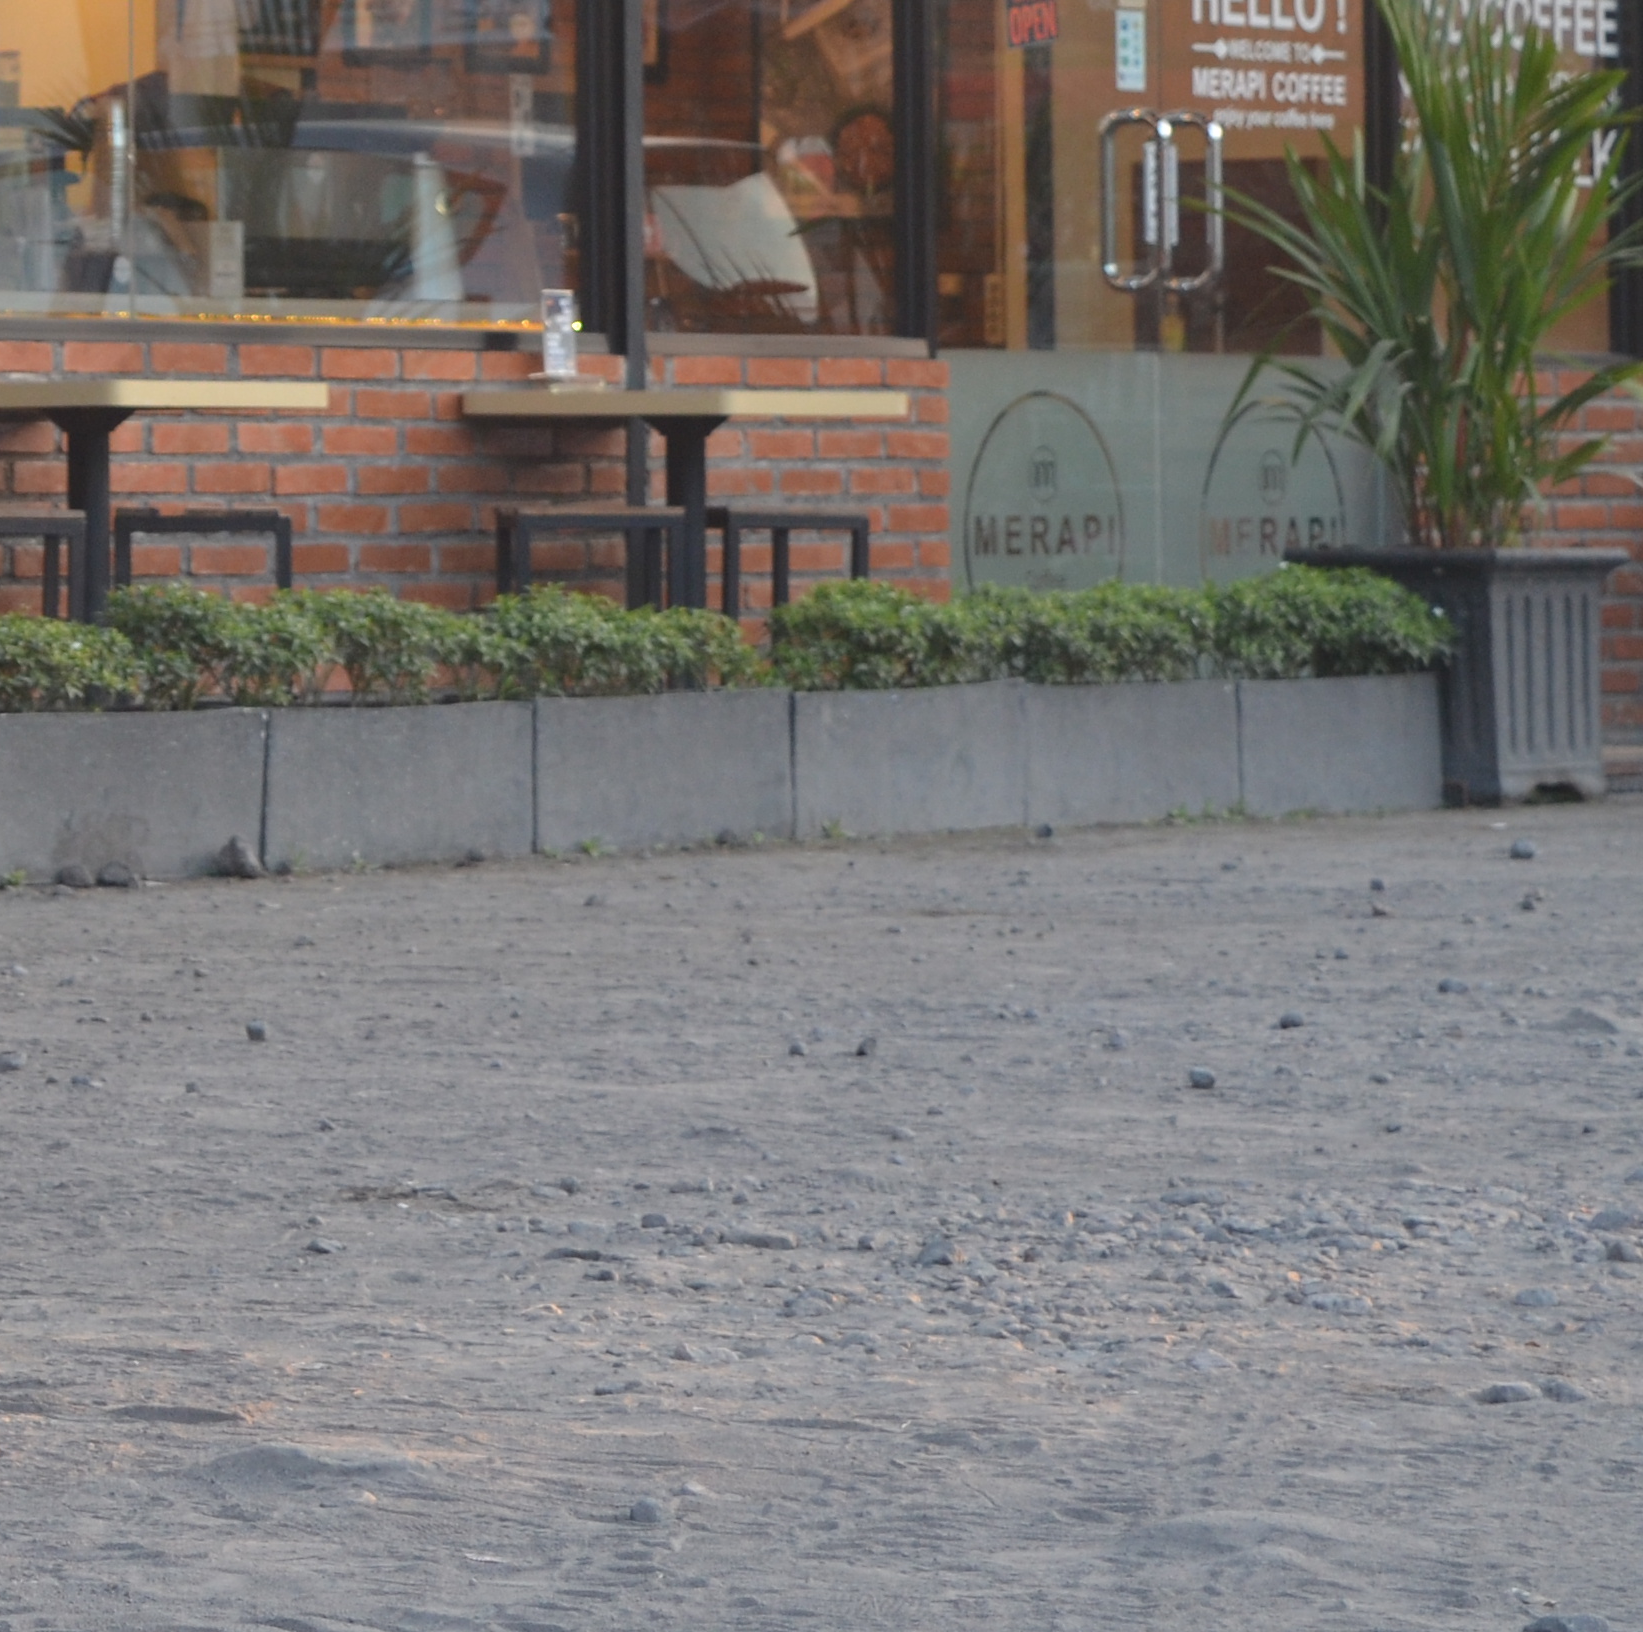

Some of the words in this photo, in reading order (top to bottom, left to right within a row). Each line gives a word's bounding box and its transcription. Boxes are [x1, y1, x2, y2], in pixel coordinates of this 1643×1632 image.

[1009, 0, 1058, 45] OPEN
[1192, 66, 1268, 101] MERAPI
[1272, 70, 1347, 106] COFFEE
[974, 514, 1116, 556] MERAPI
